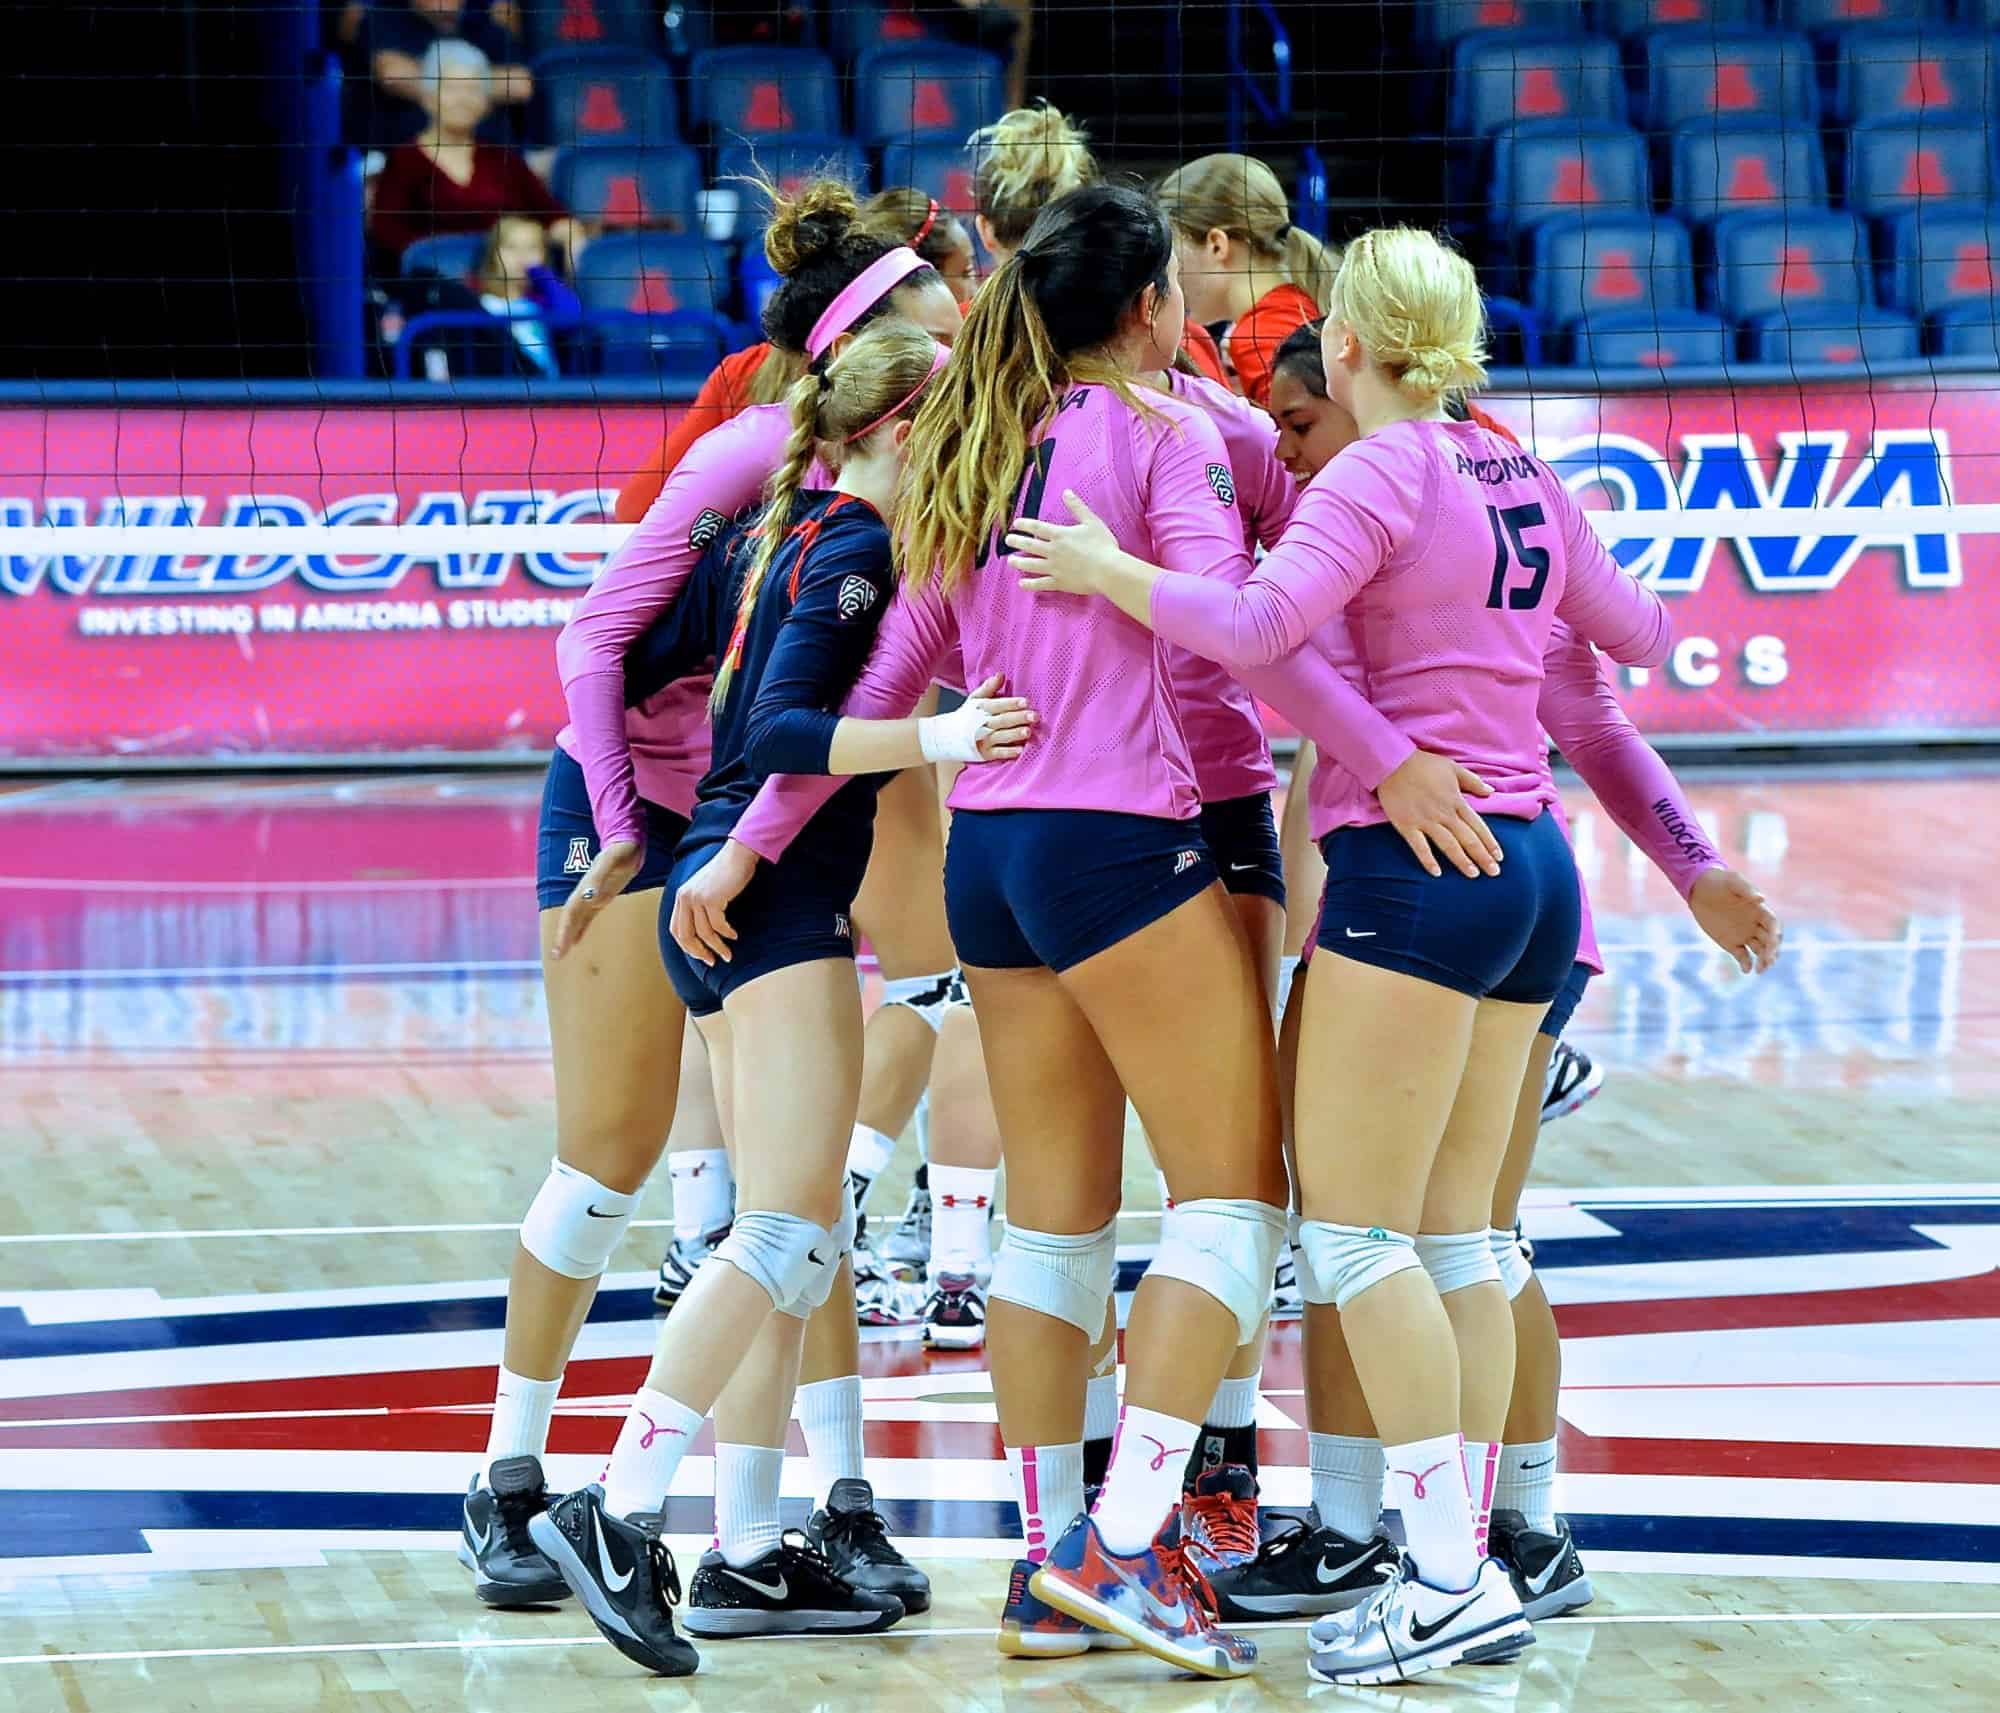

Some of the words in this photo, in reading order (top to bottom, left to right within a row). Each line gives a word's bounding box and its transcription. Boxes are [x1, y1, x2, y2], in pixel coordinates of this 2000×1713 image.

[1486, 502, 1550, 609] 15
[1545, 429, 1962, 591] ONA
[80, 605, 253, 636] INVESTING
[260, 604, 296, 632] IN
[302, 602, 441, 632] ARIZONA
